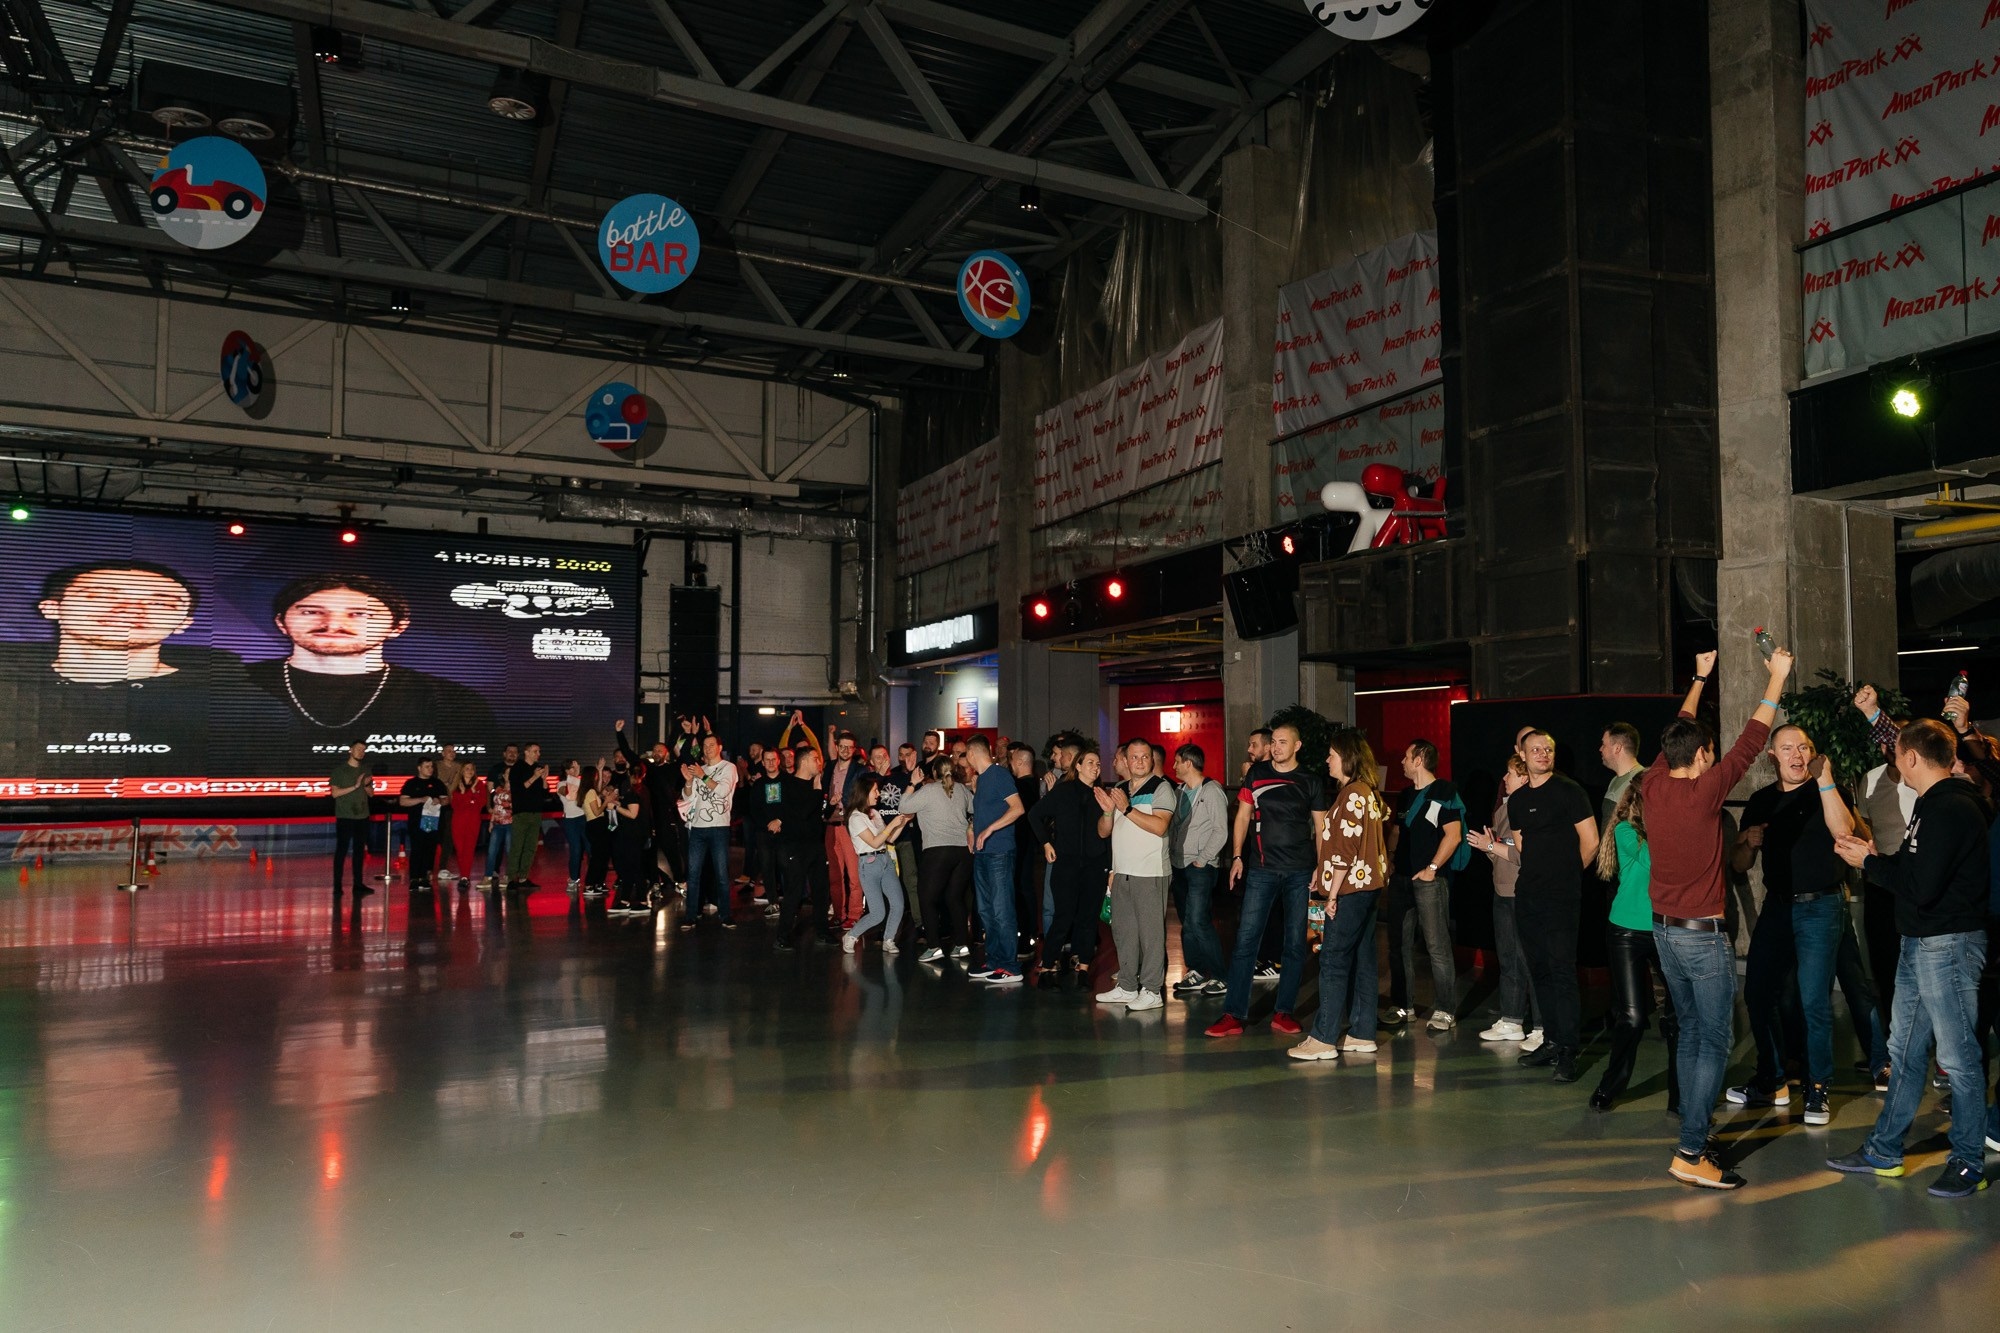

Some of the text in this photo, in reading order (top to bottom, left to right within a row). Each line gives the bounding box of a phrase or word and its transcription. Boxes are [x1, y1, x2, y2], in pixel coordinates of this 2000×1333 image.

[606, 202, 686, 248] bottle
[610, 240, 687, 274] BAR
[434, 551, 612, 572] 4 НОЯБРЯ 20:00
[87, 732, 131, 742] ЛЕВ
[366, 734, 437, 743] ДАВИД
[46, 744, 171, 753] ЕРЕМЕНКО
